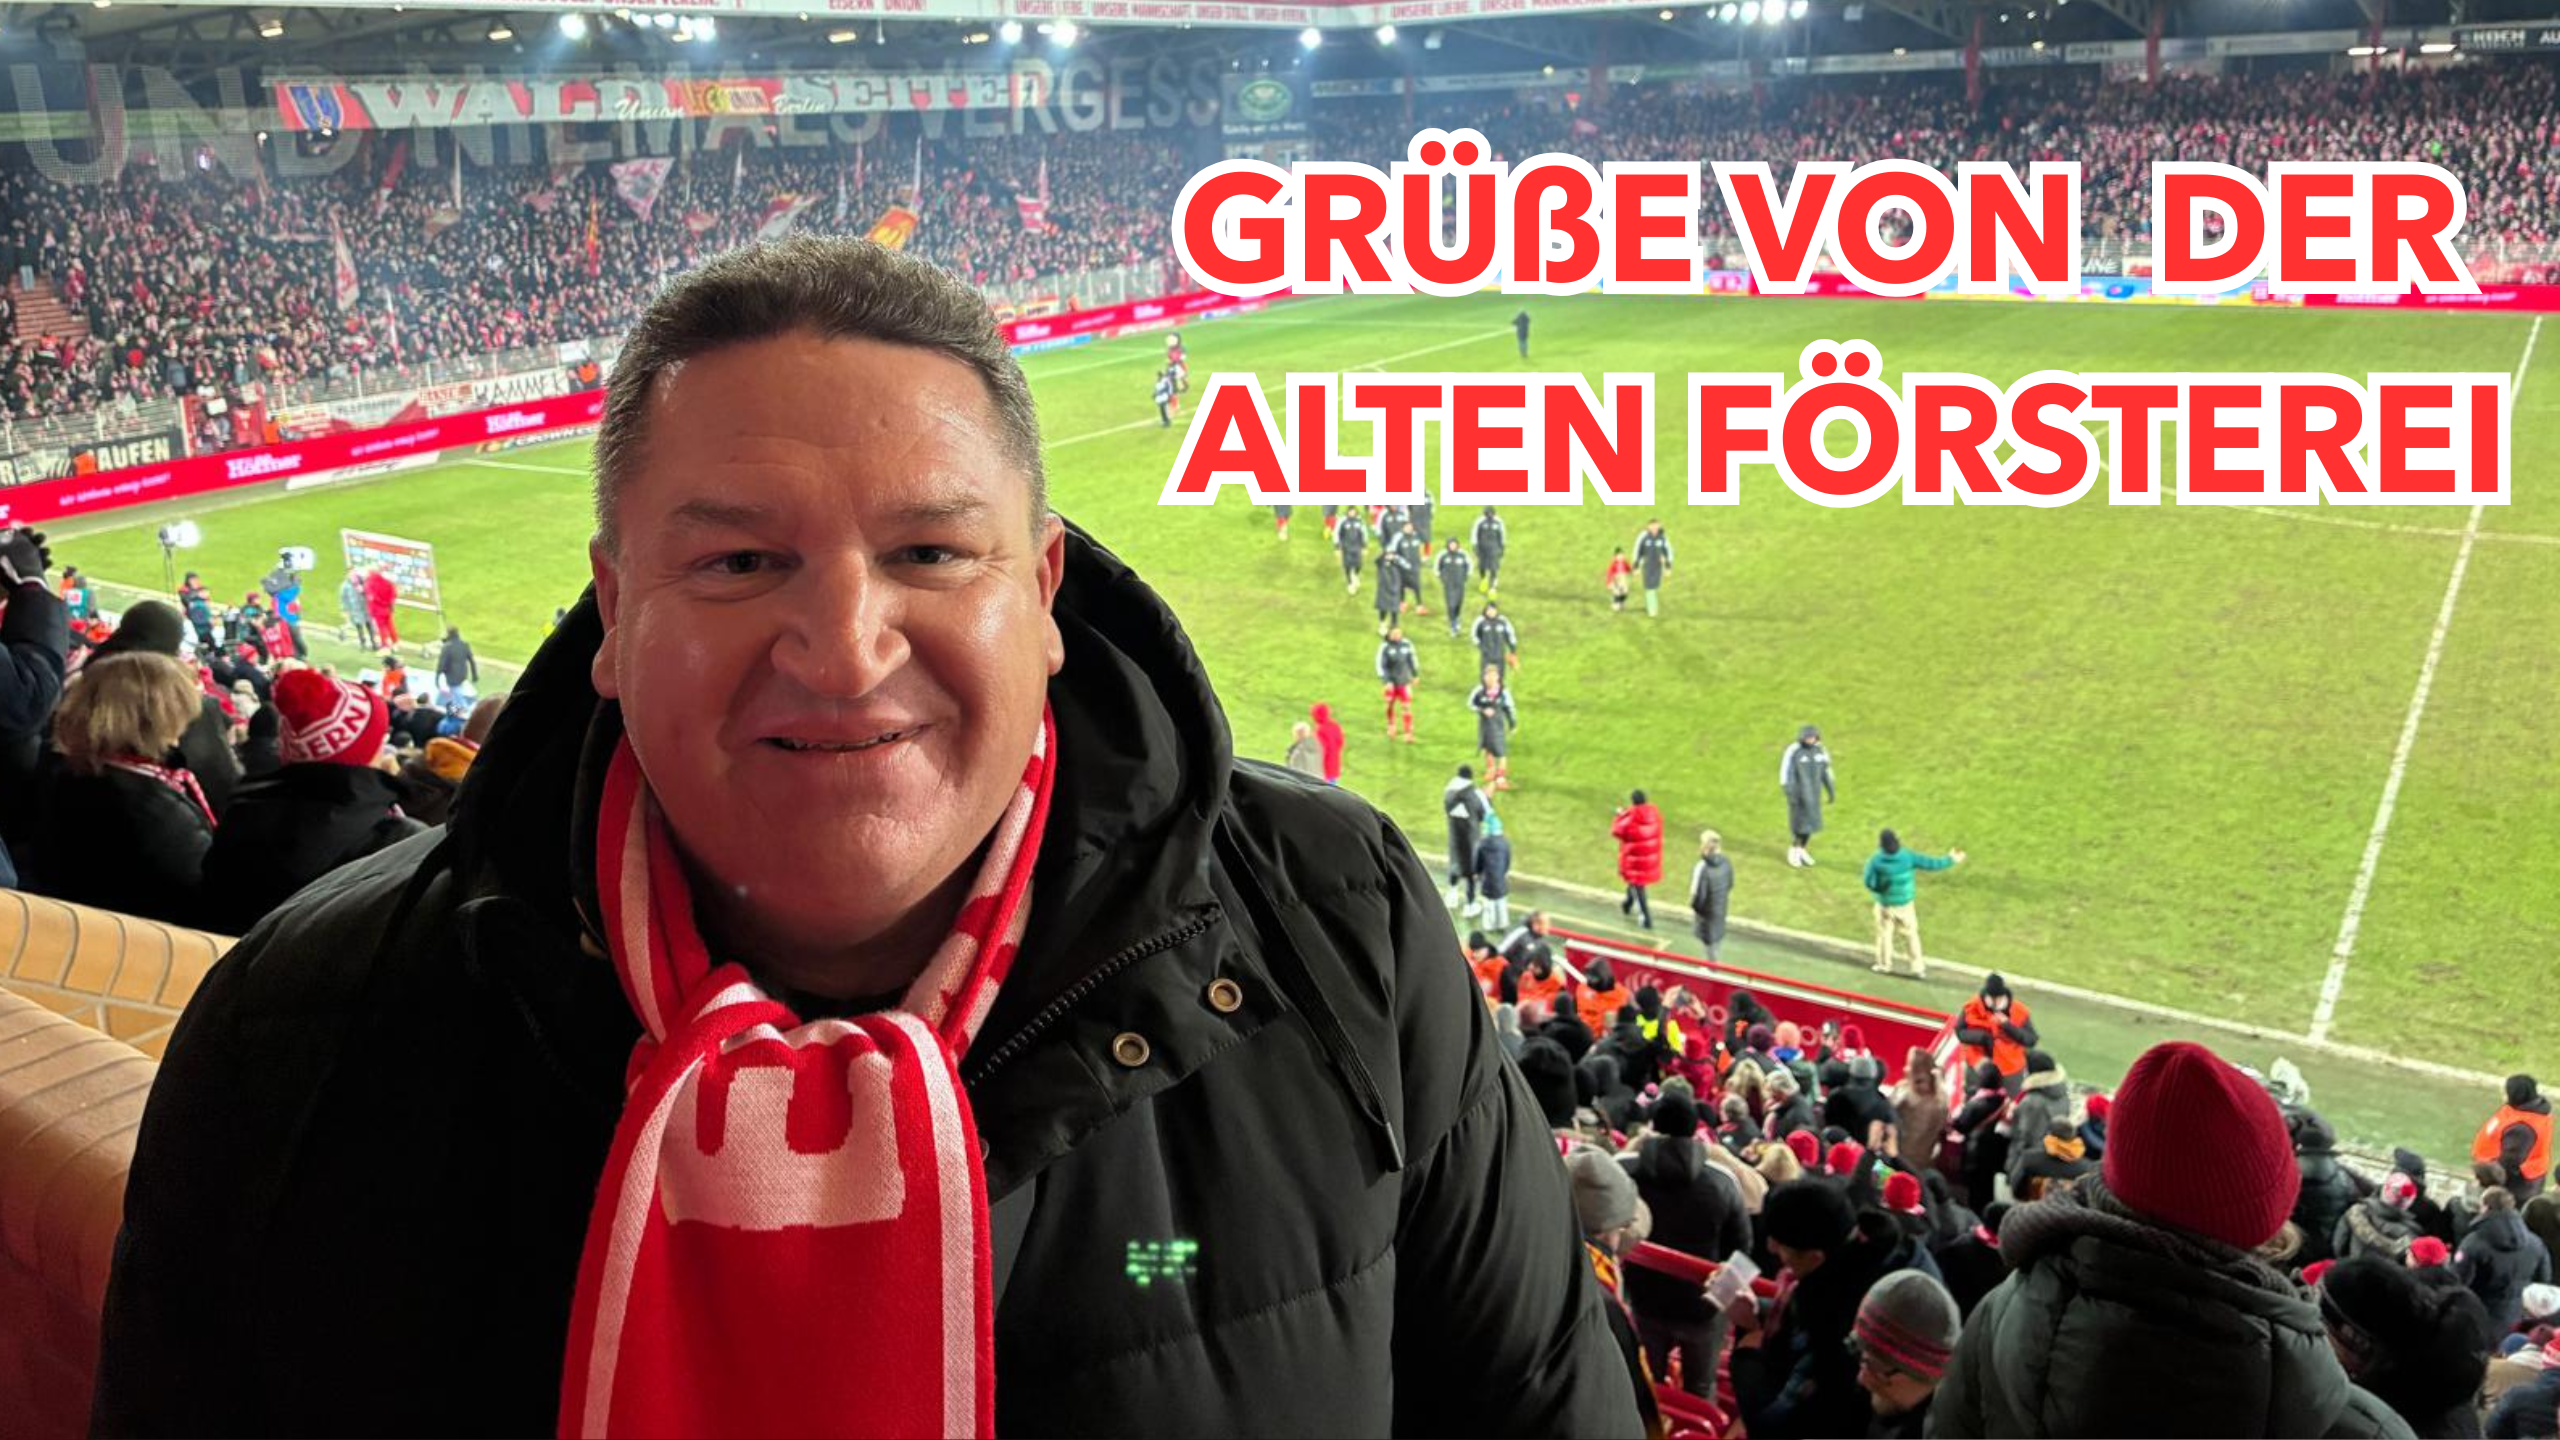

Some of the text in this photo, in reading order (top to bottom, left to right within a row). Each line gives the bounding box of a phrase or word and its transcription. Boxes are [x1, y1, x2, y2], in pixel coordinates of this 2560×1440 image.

[613, 97, 686, 120] Union
[87, 437, 171, 474] AUFEN
[226, 454, 302, 479] Höffner
